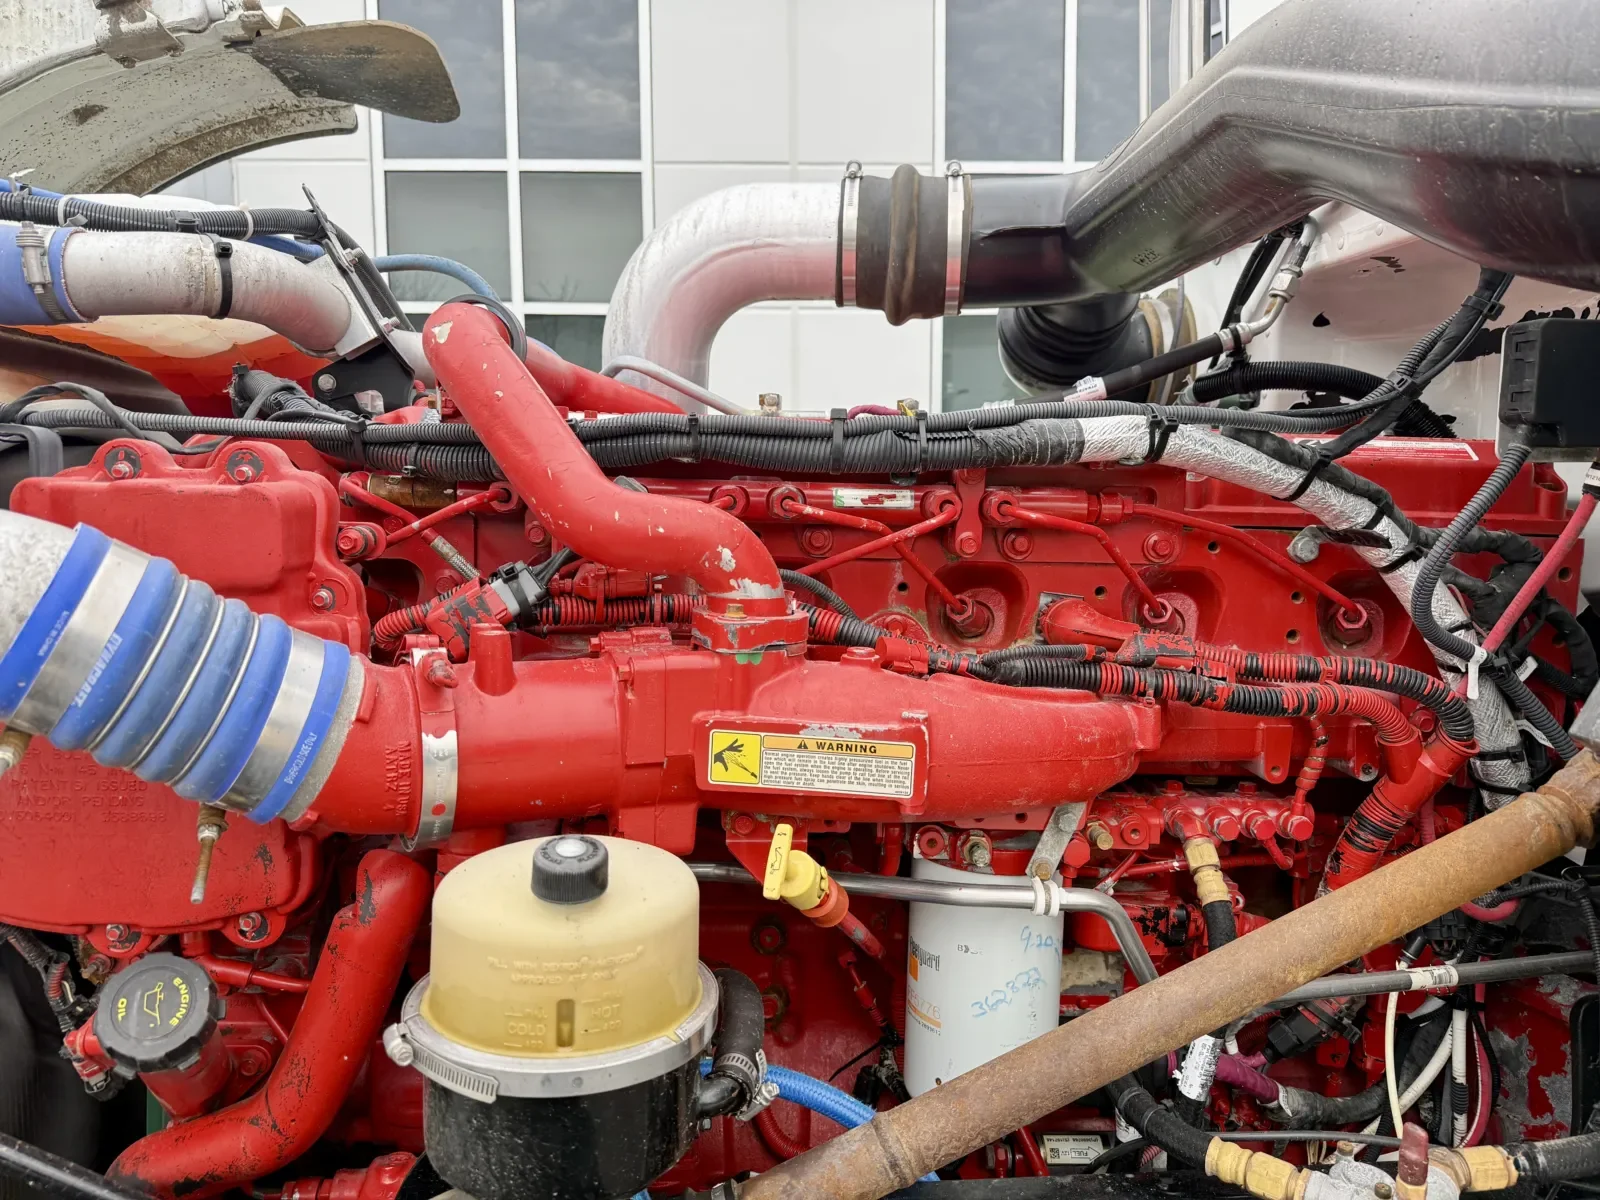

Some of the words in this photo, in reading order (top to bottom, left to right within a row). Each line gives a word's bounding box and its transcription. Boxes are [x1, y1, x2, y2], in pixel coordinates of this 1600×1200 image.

[72, 634, 123, 708] DYNACRAFT
[815, 741, 876, 753] WARNING
[398, 740, 412, 777] MADE
[97, 779, 149, 791] ISSUED
[399, 781, 412, 794] IN
[17, 794, 71, 806] AND/OR
[81, 795, 145, 807] PENDING
[395, 795, 410, 816] USA
[510, 973, 563, 986] APPROVED
[169, 976, 191, 1027] ENGINE
[116, 997, 128, 1024] OIL
[590, 1004, 621, 1018] HOT
[508, 1022, 546, 1036] COLD
